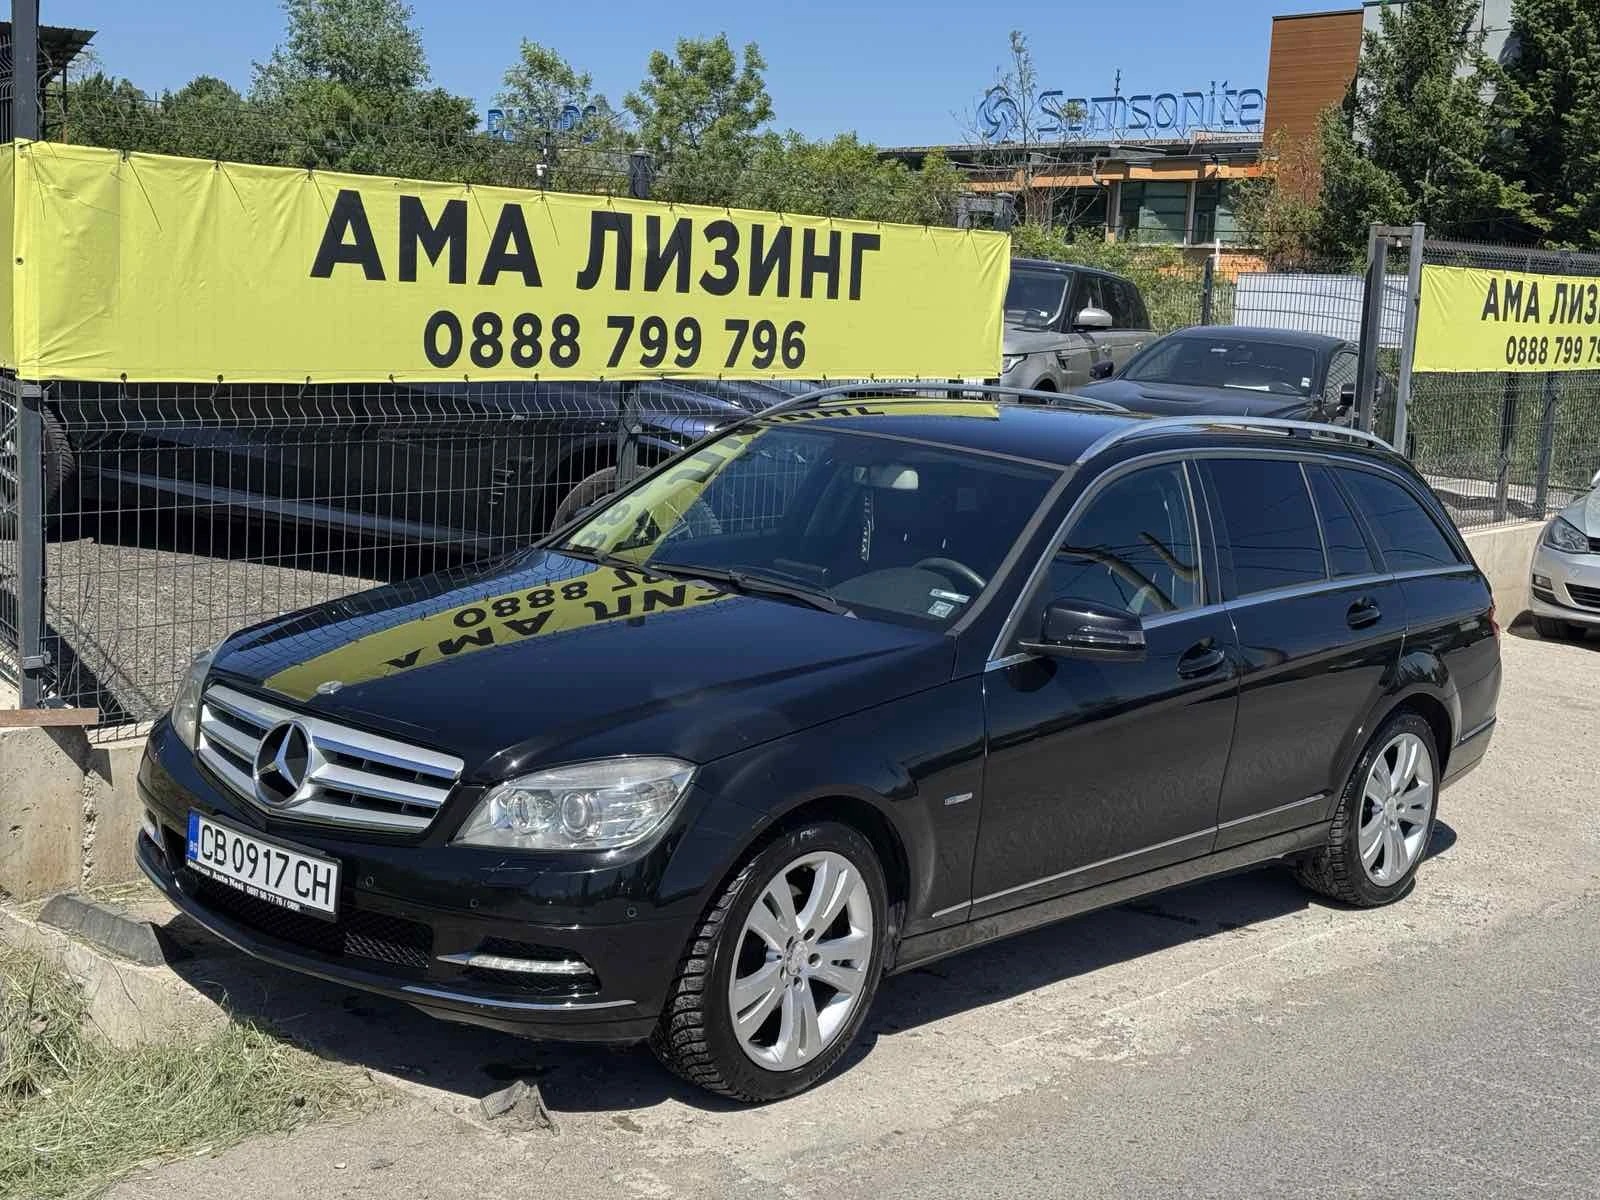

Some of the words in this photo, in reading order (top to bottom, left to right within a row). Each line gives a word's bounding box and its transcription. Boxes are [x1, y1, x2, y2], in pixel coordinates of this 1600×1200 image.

[309, 189, 543, 288] АМА
[576, 210, 881, 300] ЛИЗИНГ
[1481, 278, 1540, 323] АМА
[1549, 283, 1600, 325] ЛИЗ
[424, 310, 580, 368] 0888
[606, 316, 701, 368] 799
[724, 319, 806, 369] 796
[1506, 335, 1548, 365] 0888
[1554, 336, 1583, 364] 799
[201, 824, 227, 866] CB
[232, 838, 290, 889] 0917
[294, 860, 331, 905] CH
